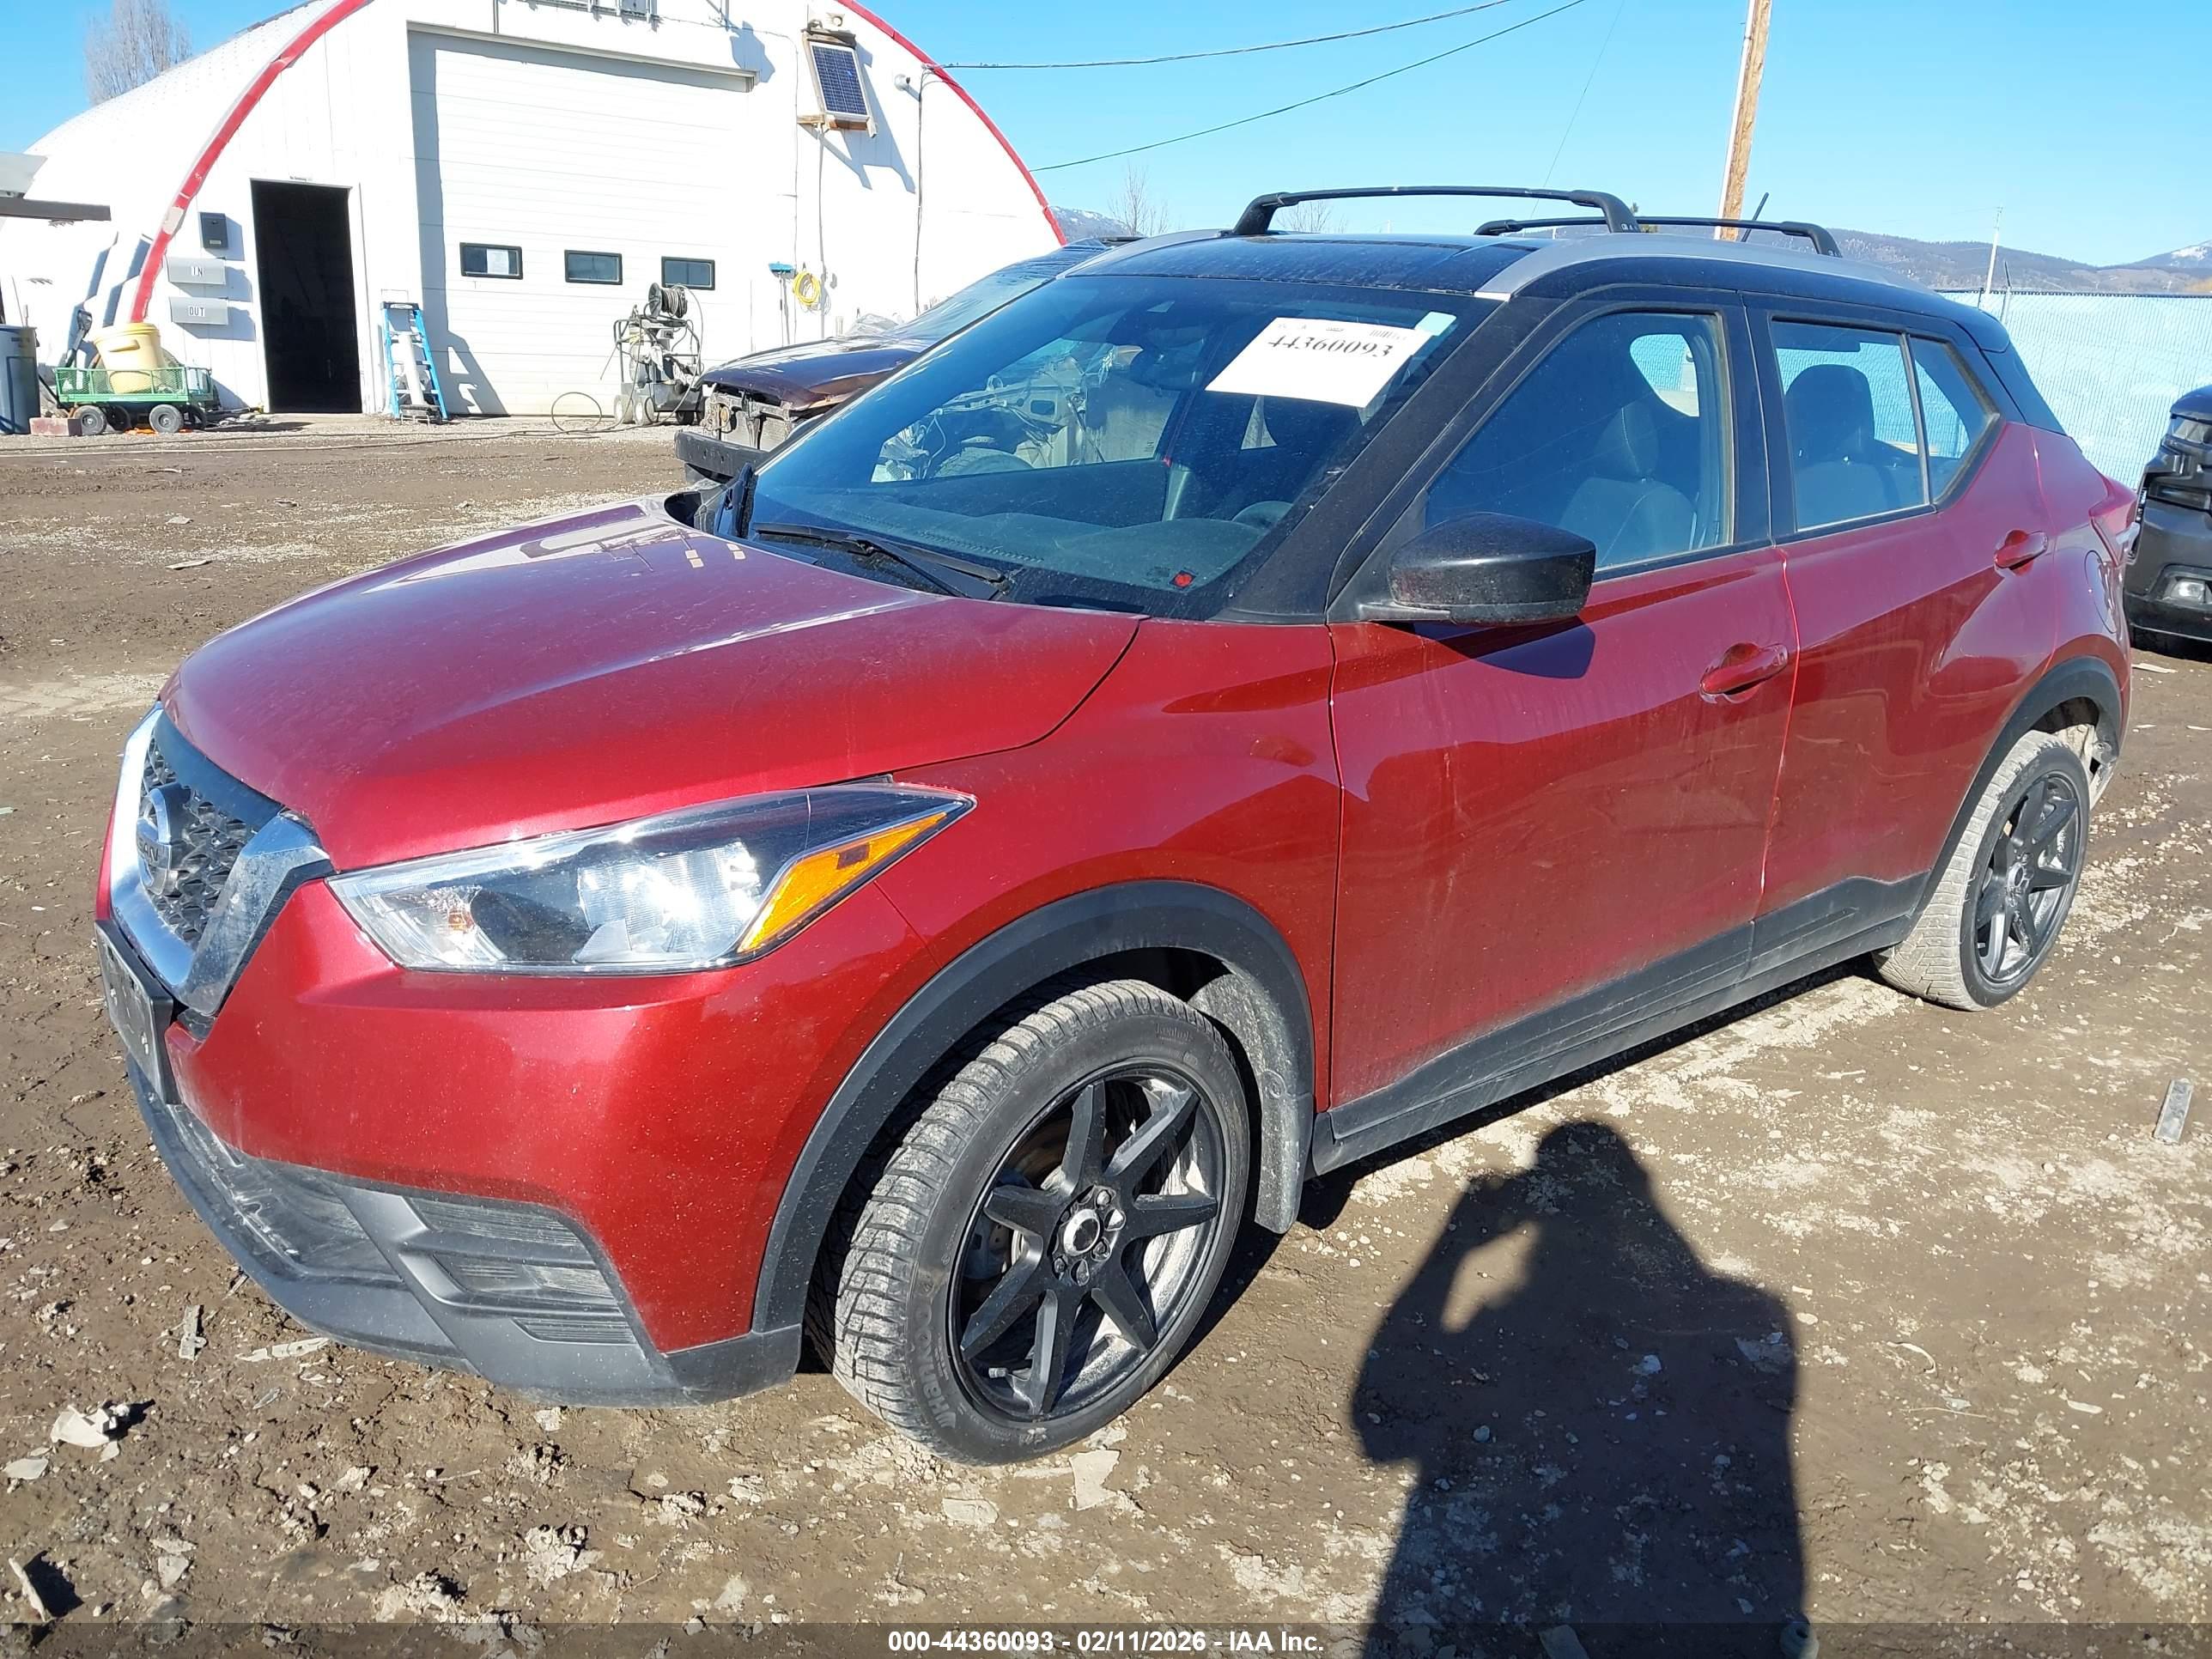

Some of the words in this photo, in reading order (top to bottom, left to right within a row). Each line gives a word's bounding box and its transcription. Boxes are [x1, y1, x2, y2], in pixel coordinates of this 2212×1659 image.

[192, 266, 204, 276] IN
[189, 307, 204, 317] OUT
[1267, 335, 1393, 357] 44360093
